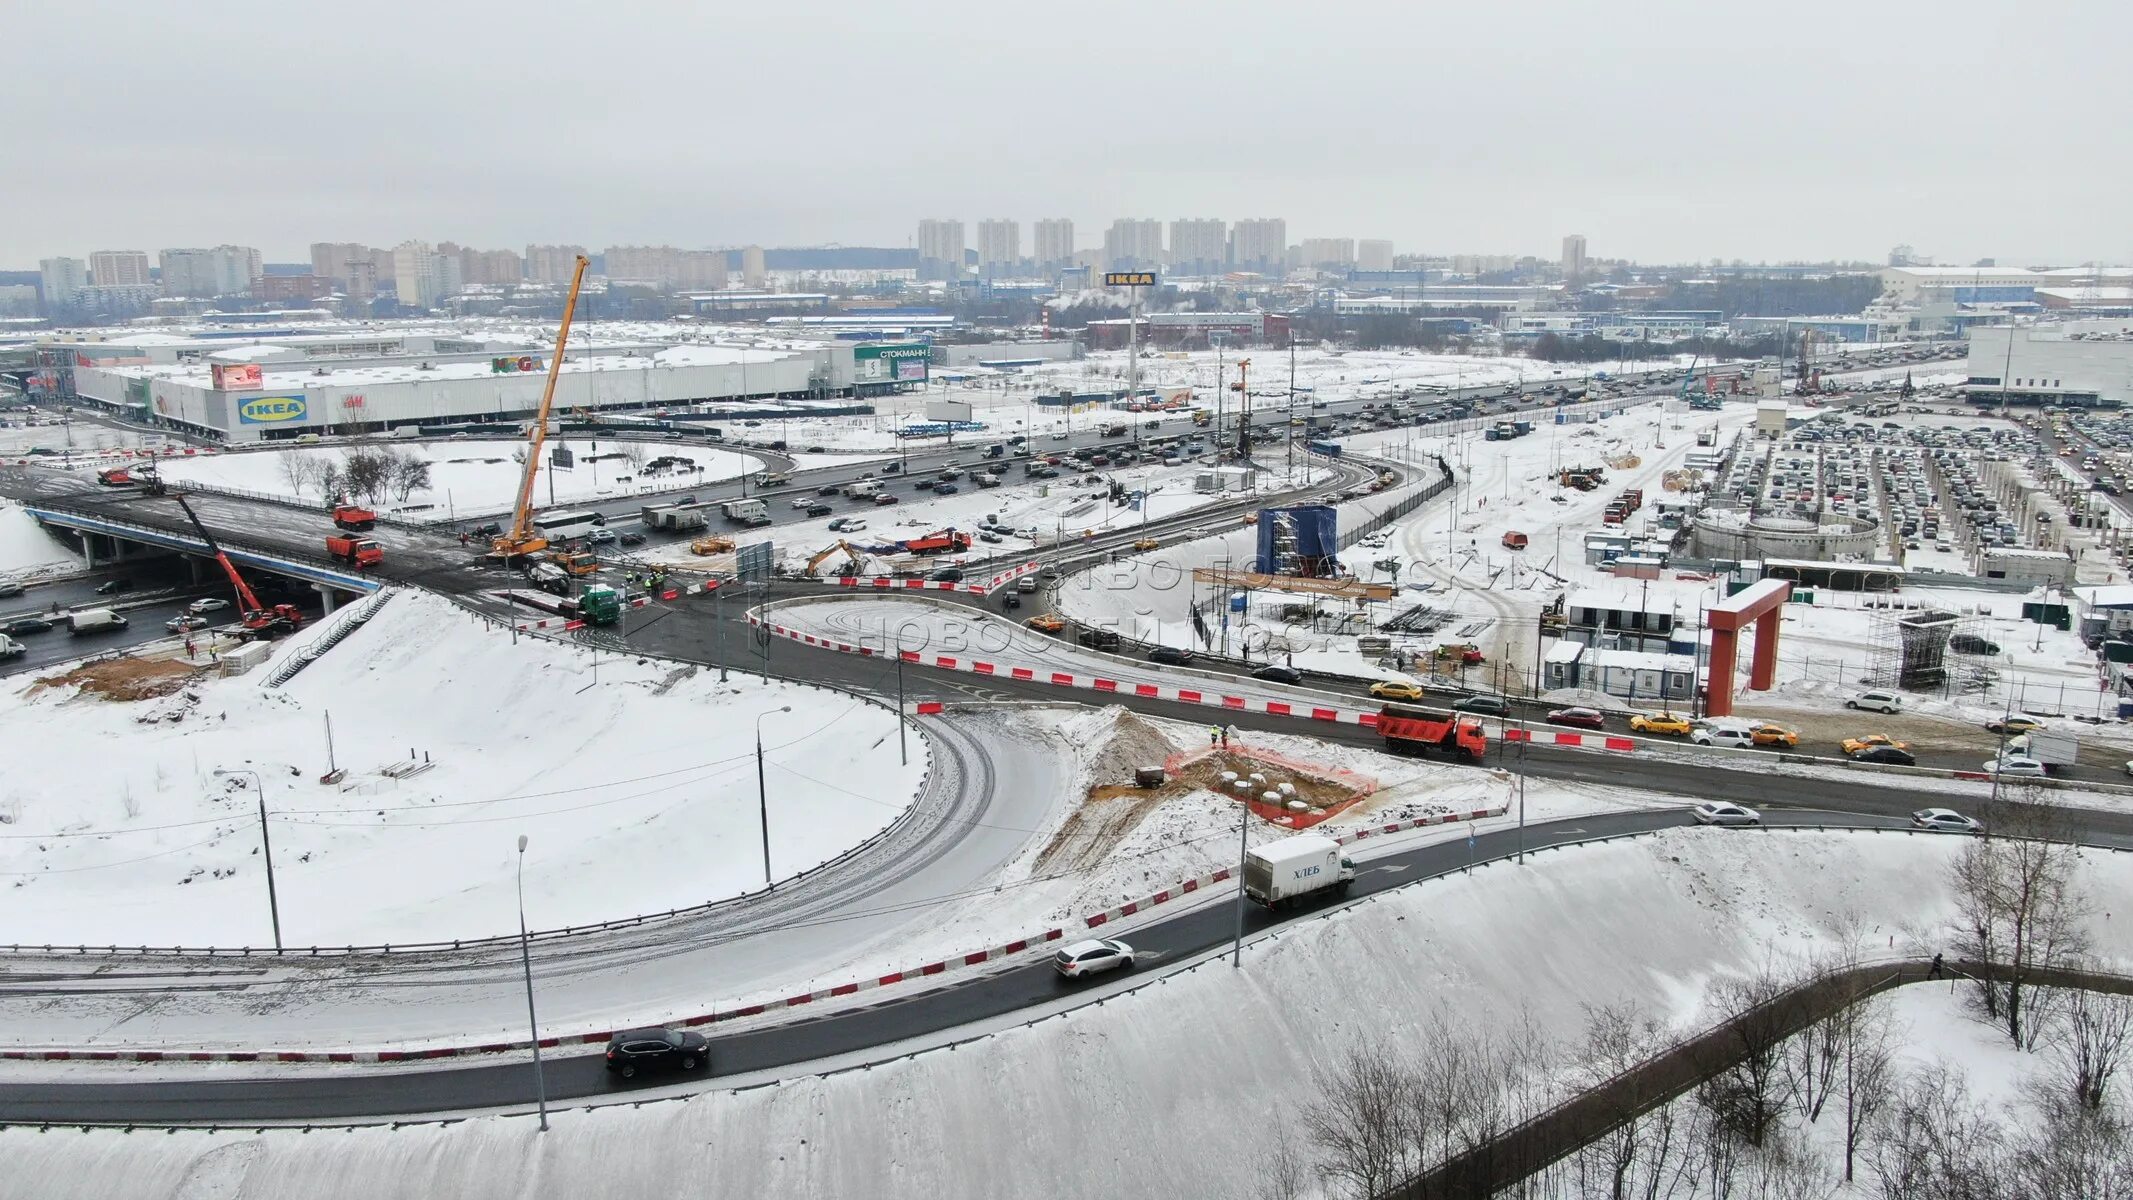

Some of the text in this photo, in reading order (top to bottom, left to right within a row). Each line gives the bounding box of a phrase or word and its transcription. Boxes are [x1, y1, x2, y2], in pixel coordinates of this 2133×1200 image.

[1108, 274, 1153, 284] IKEA
[880, 349, 926, 359] СТОКМАНН
[247, 402, 300, 416] IKEA
[1293, 864, 1320, 880] ХЛЕБ
